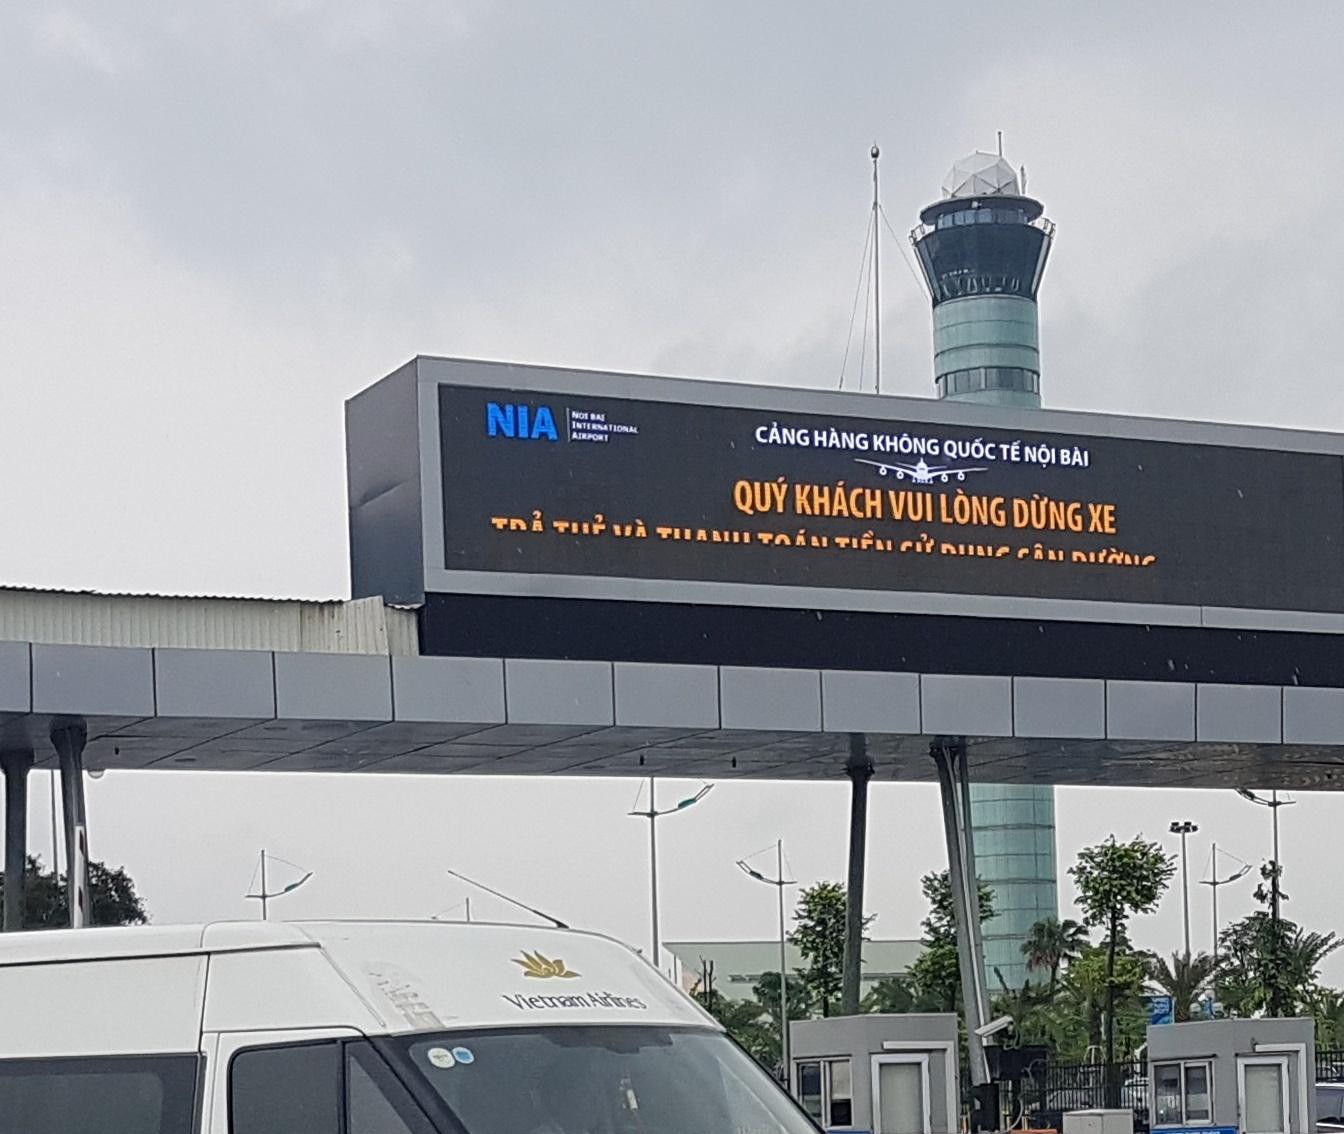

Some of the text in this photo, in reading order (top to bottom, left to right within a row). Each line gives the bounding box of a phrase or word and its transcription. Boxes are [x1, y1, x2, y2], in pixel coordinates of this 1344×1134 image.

[487, 402, 558, 440] NIA
[572, 422, 639, 434] INTERNATIONAL
[572, 433, 608, 442] AIRPORT
[755, 421, 1089, 469] CẢNG HÀNG KHÔNG QUỐC TẾ NỘI BÀI
[734, 476, 1116, 534] QUÝ KHÁCH VUI LÒNG DỪNG XE
[502, 991, 647, 1010] Vietnam Airlines
